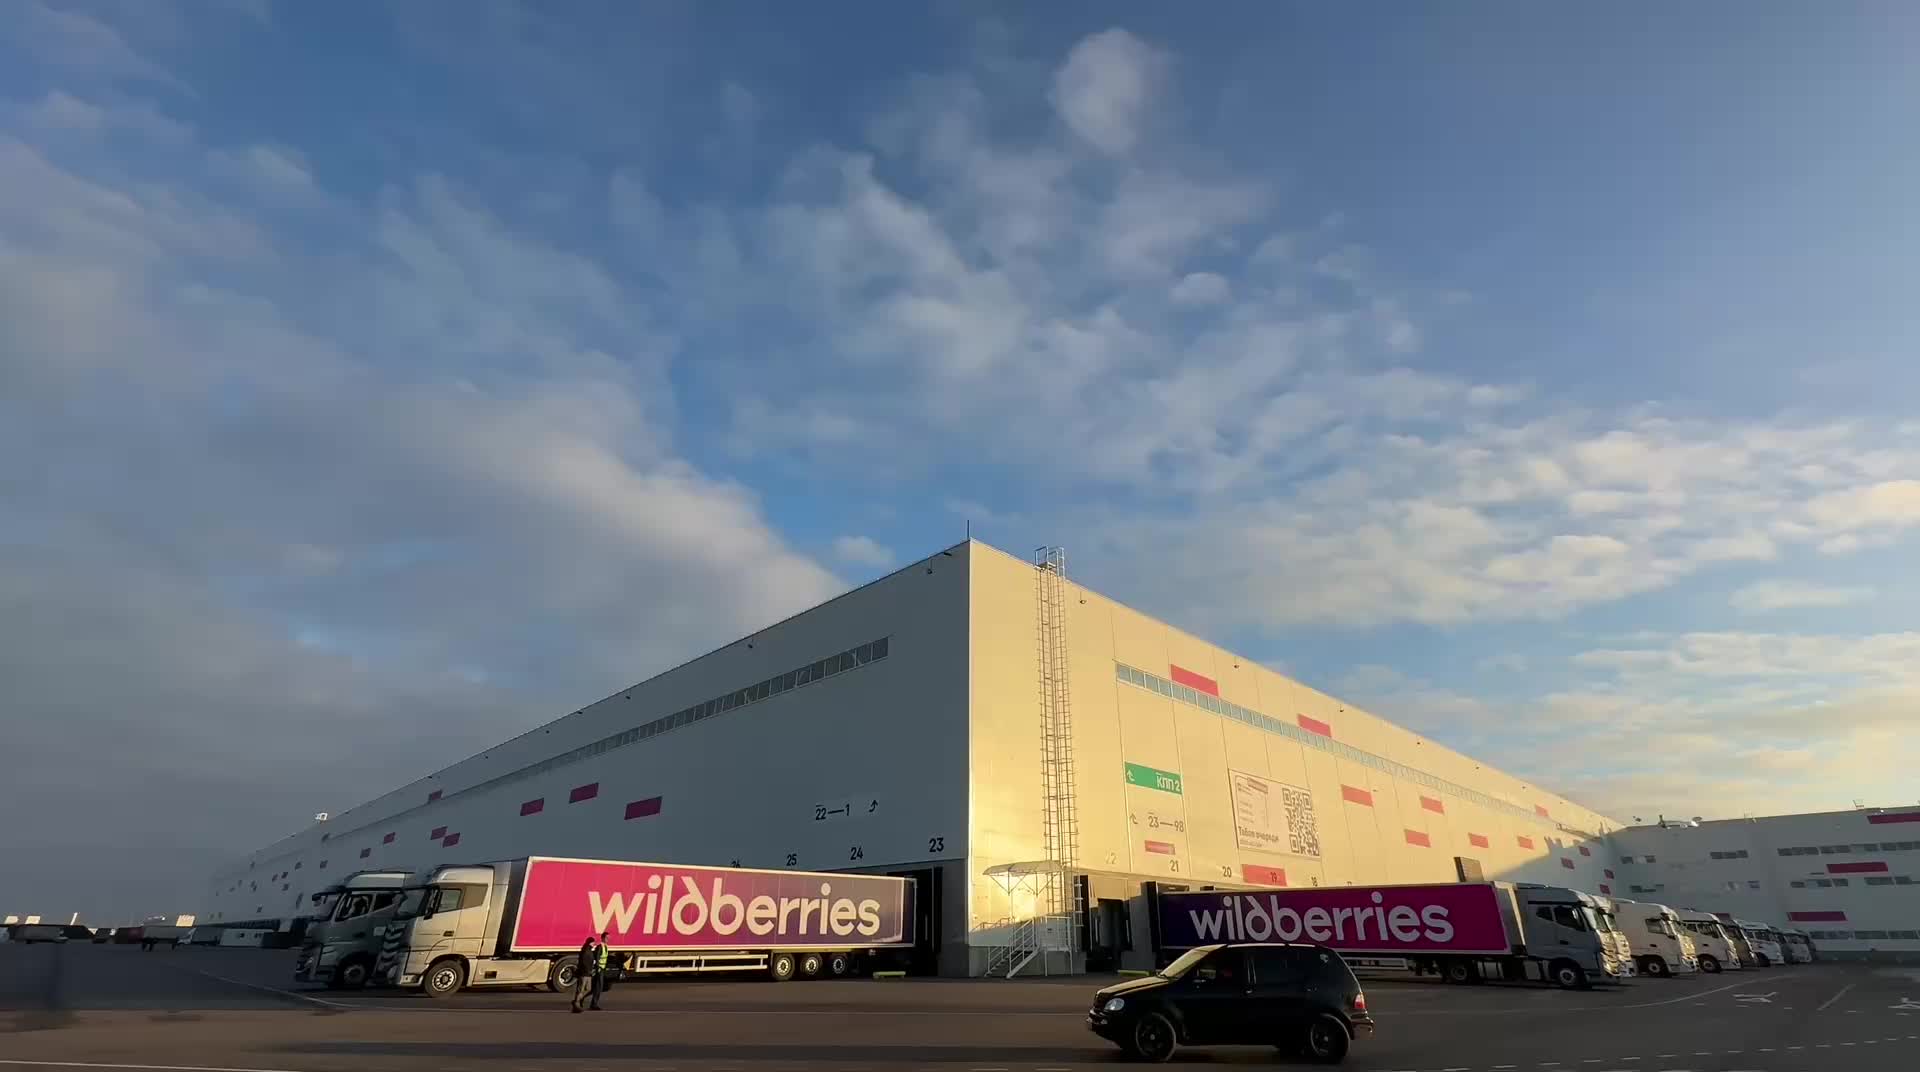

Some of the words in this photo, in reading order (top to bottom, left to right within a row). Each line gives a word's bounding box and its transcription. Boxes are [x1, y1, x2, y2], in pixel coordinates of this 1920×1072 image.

[1156, 775, 1174, 790] КПП
[1174, 780, 1181, 792] 2
[929, 837, 944, 853] 23
[786, 854, 797, 866] 25
[850, 846, 863, 860] 24
[1170, 860, 1179, 872] 21
[1222, 866, 1232, 878] 20
[588, 875, 880, 936] wildberries
[1189, 891, 1454, 943] wildberries
